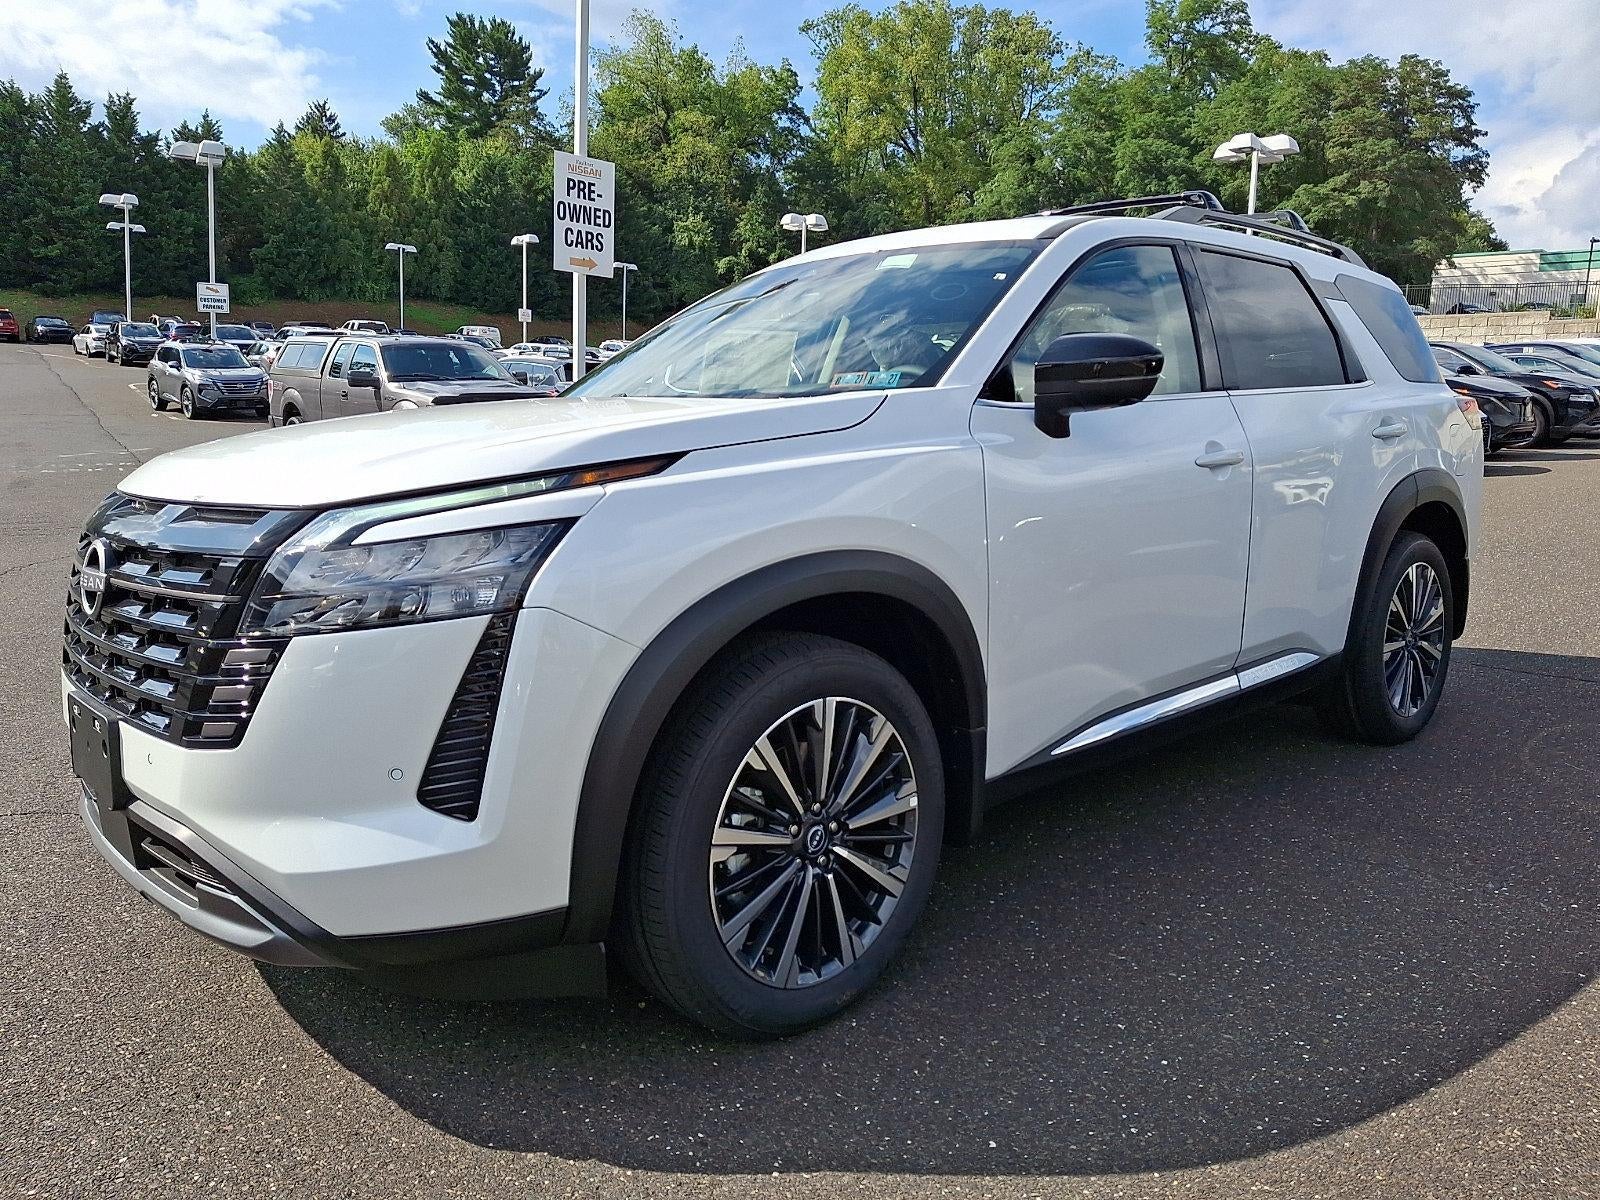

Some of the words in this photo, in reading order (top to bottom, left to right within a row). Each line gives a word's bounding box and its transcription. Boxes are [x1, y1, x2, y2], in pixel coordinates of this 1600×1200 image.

[568, 163, 602, 177] NISSAN
[566, 177, 603, 202] PRE-
[556, 200, 612, 229] OWNED
[564, 226, 604, 252] CARS
